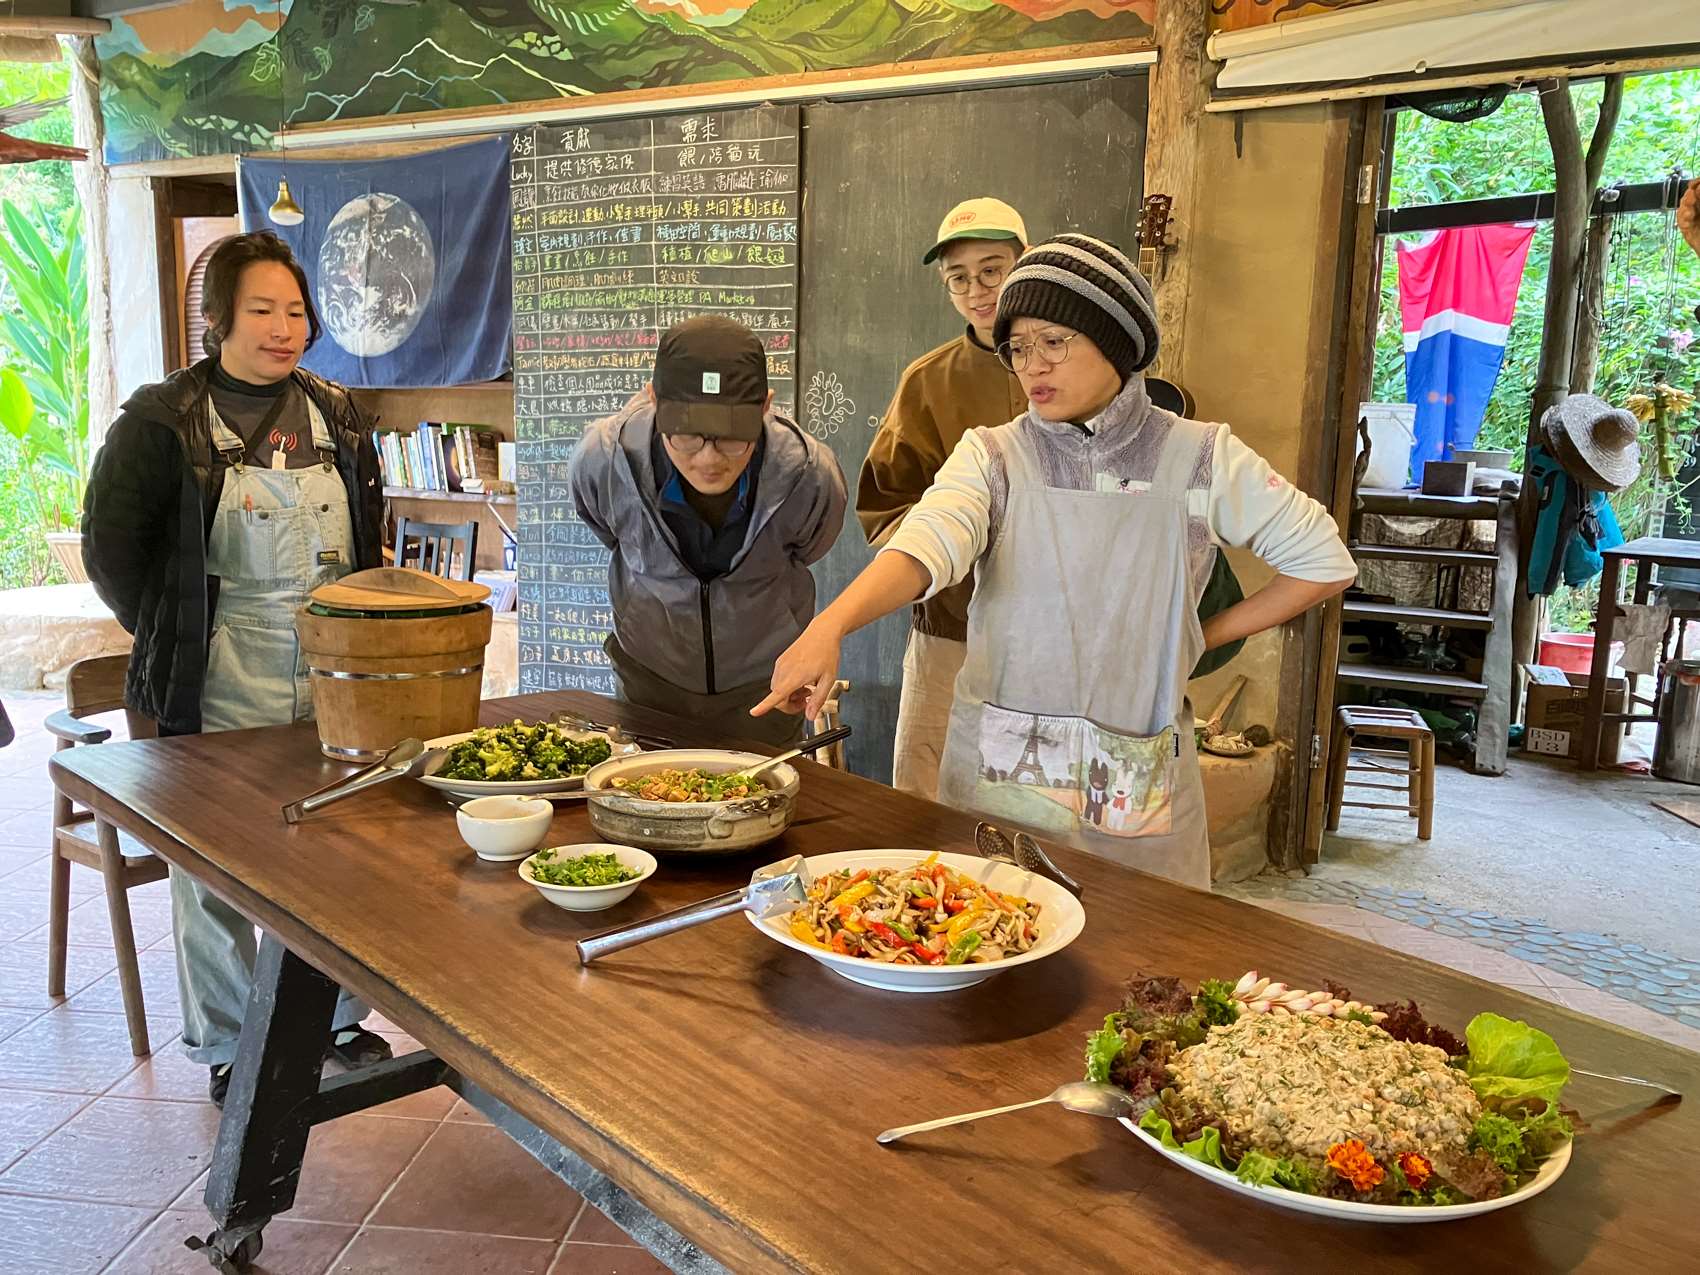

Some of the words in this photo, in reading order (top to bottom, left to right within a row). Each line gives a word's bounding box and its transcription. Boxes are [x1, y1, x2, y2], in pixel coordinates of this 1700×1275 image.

[512, 132, 534, 155] 名字
[560, 127, 591, 152] 貢獻
[680, 115, 719, 143] 需求
[1529, 728, 1566, 742] BSD
